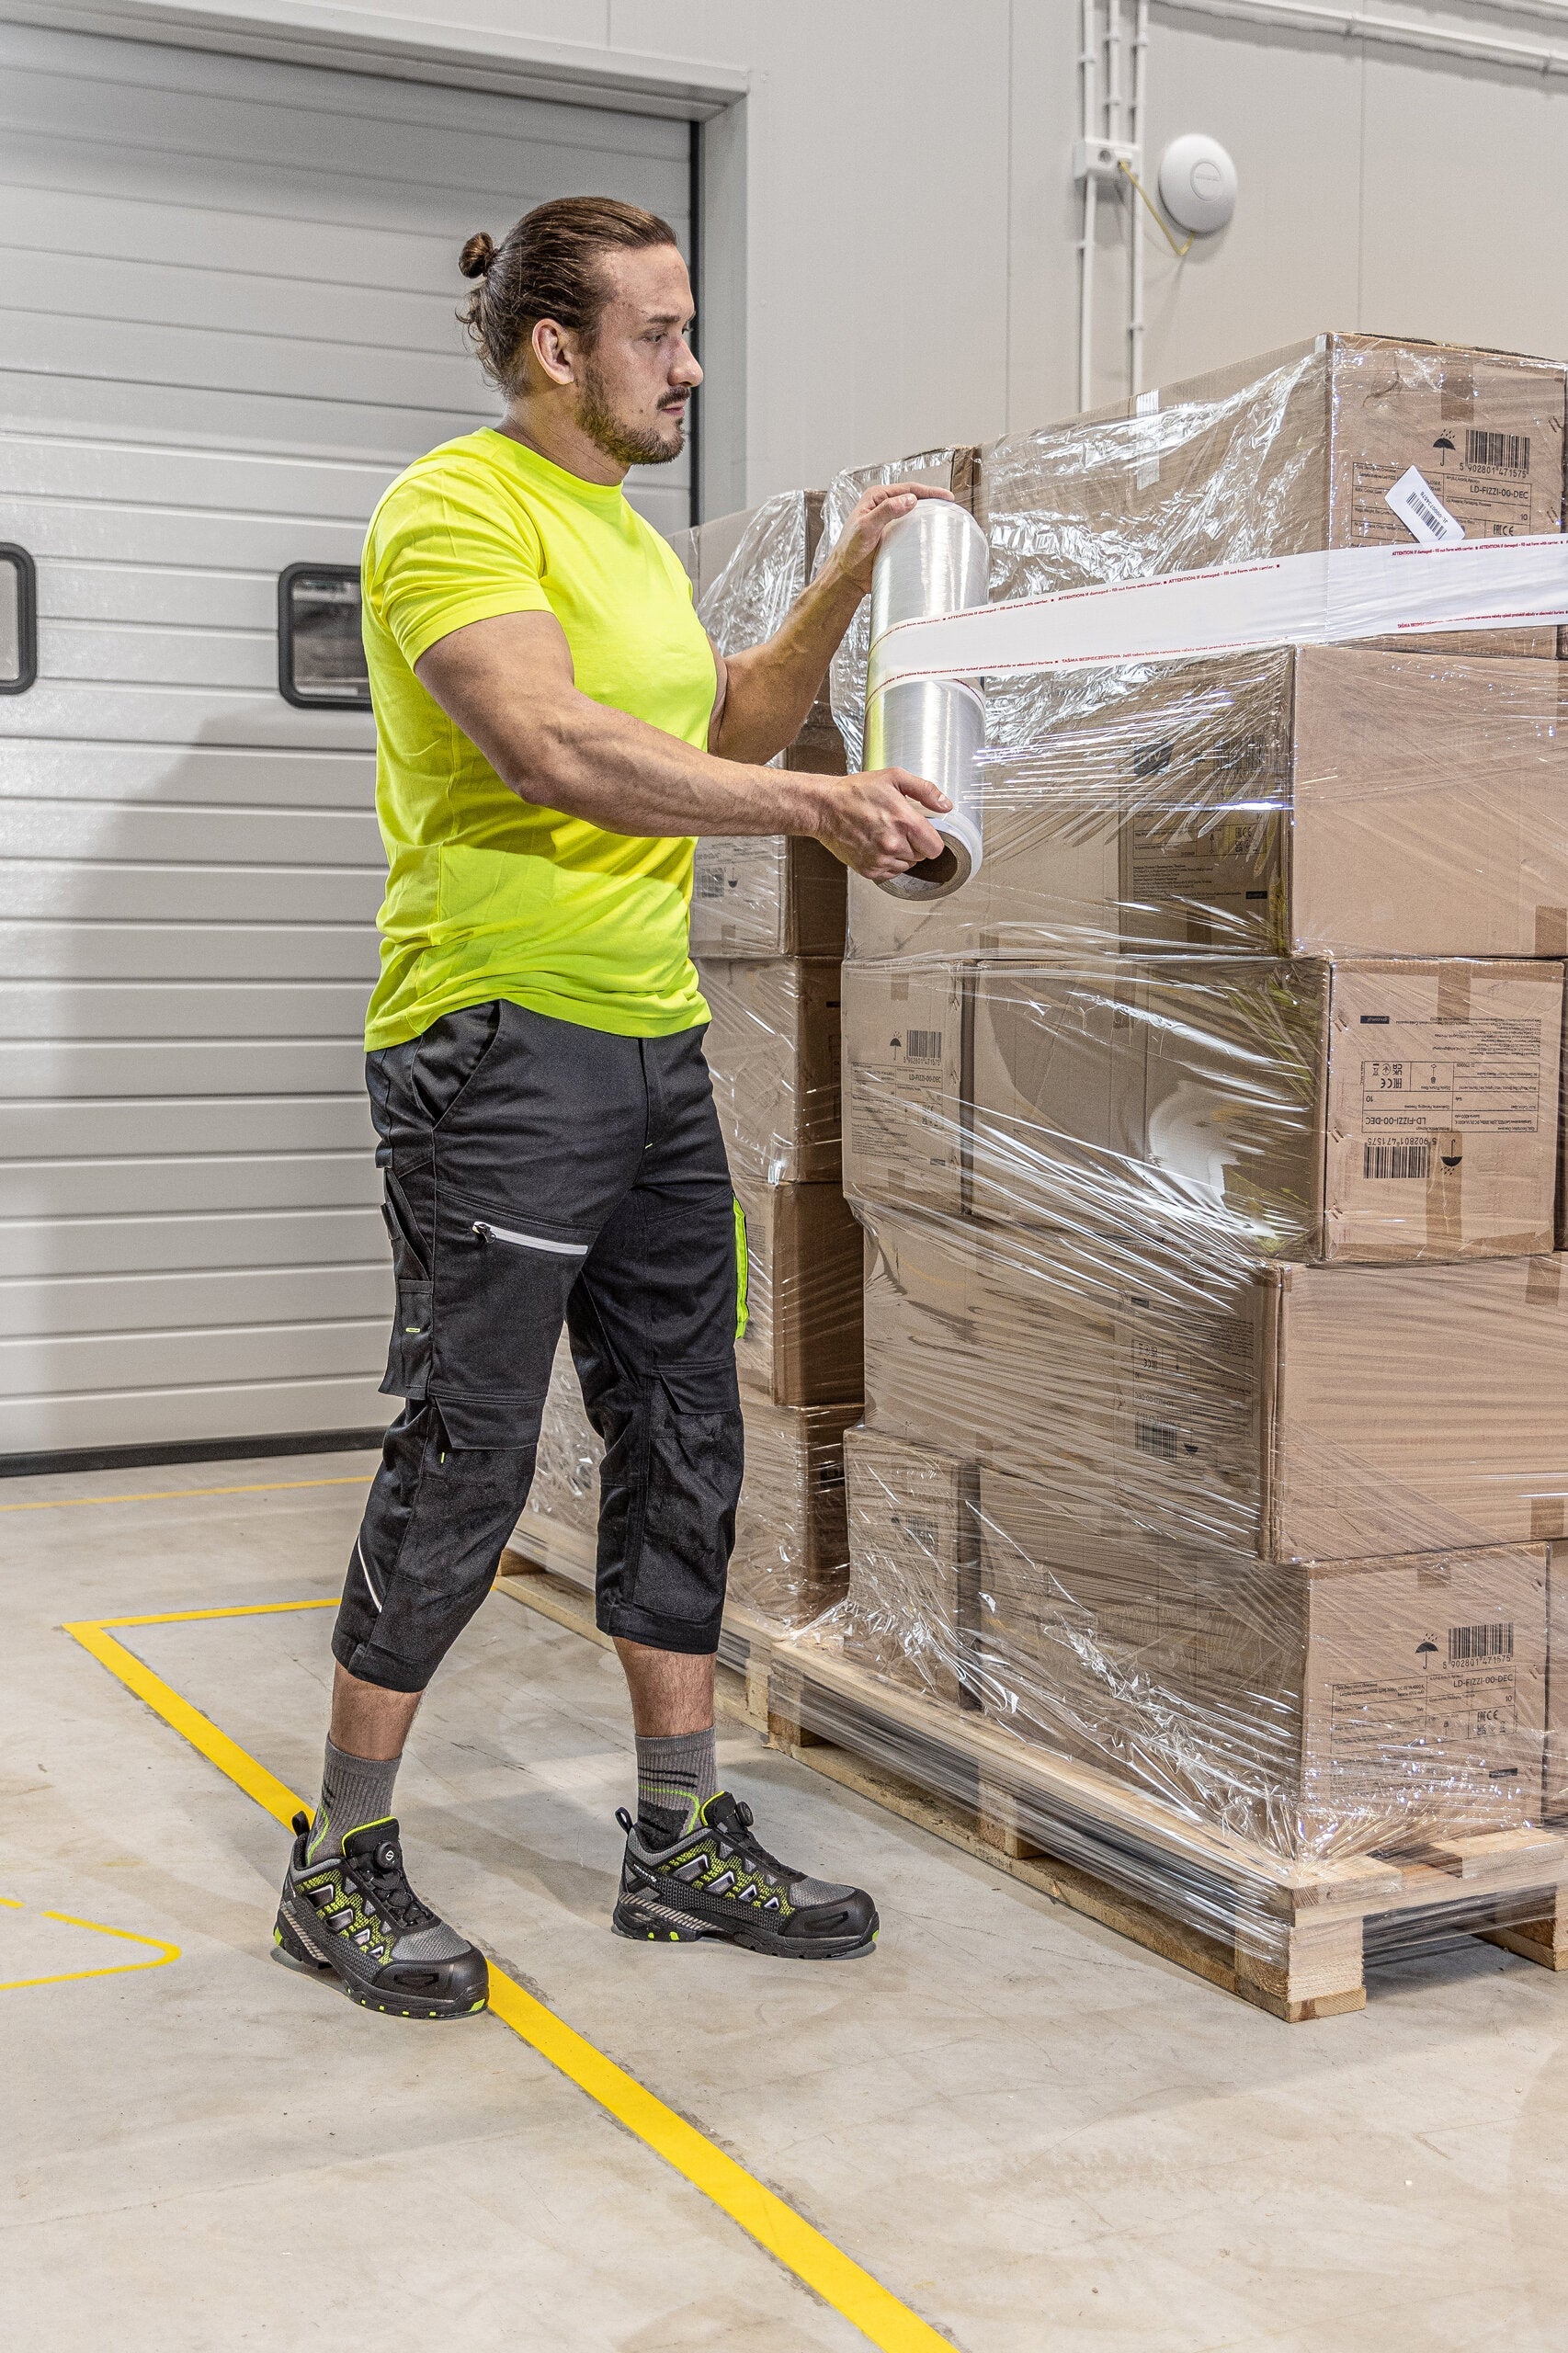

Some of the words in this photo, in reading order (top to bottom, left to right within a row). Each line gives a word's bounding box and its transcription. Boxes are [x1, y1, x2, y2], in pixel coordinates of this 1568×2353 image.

[1468, 464, 1495, 475] 902801
[1499, 467, 1527, 478] 471575
[1470, 485, 1528, 499] LD-FIZZI-00-DEC
[1365, 1117, 1426, 1125] LD-FIZZI-00-DEC
[1367, 1137, 1396, 1146] 471575
[1400, 1137, 1428, 1146] 902801
[1451, 1658, 1479, 1668] 902801
[1454, 1674, 1513, 1688] LD-FIZZI-00-DEC
